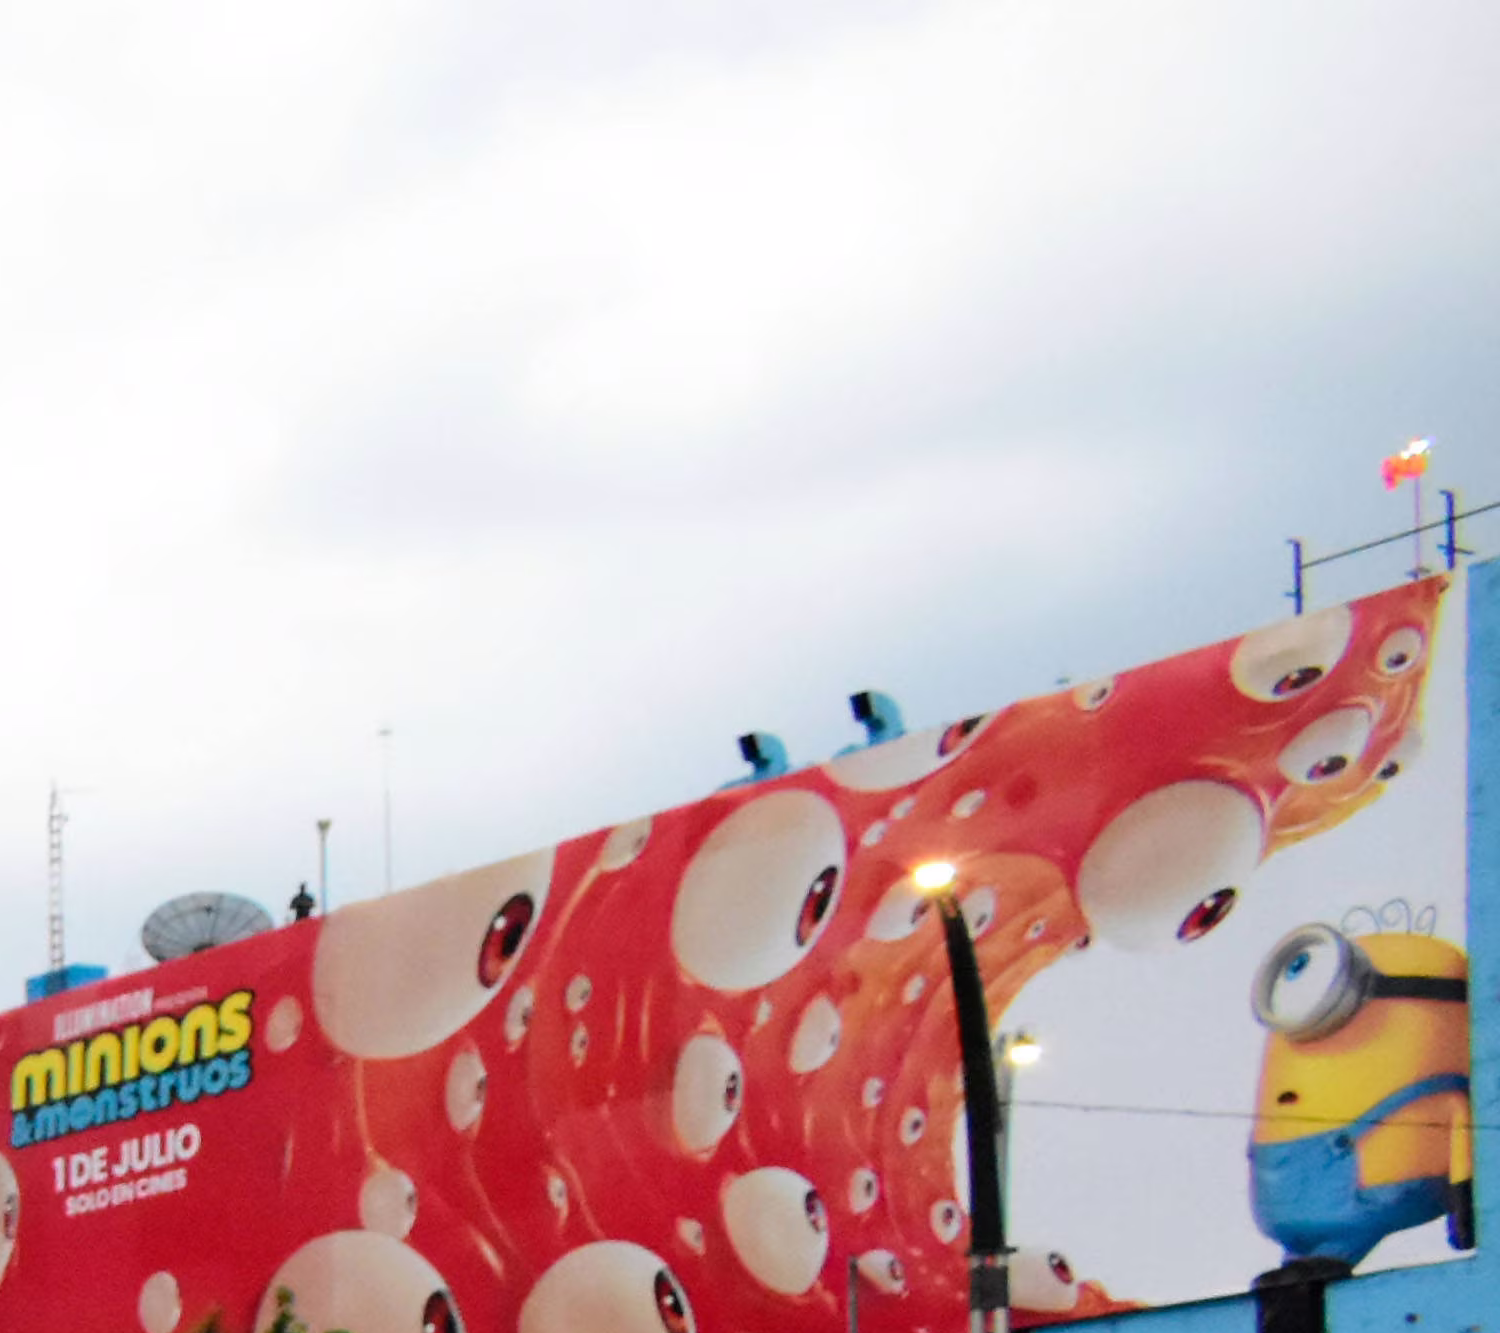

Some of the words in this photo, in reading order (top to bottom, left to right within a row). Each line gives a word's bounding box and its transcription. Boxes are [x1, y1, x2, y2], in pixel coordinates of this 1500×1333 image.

[52, 1157, 65, 1193] 1
[69, 1148, 108, 1189] DE
[112, 1124, 201, 1178] JULIO
[66, 1188, 112, 1216] SOLO
[112, 1182, 135, 1206] EN
[135, 1168, 187, 1199] CINES
